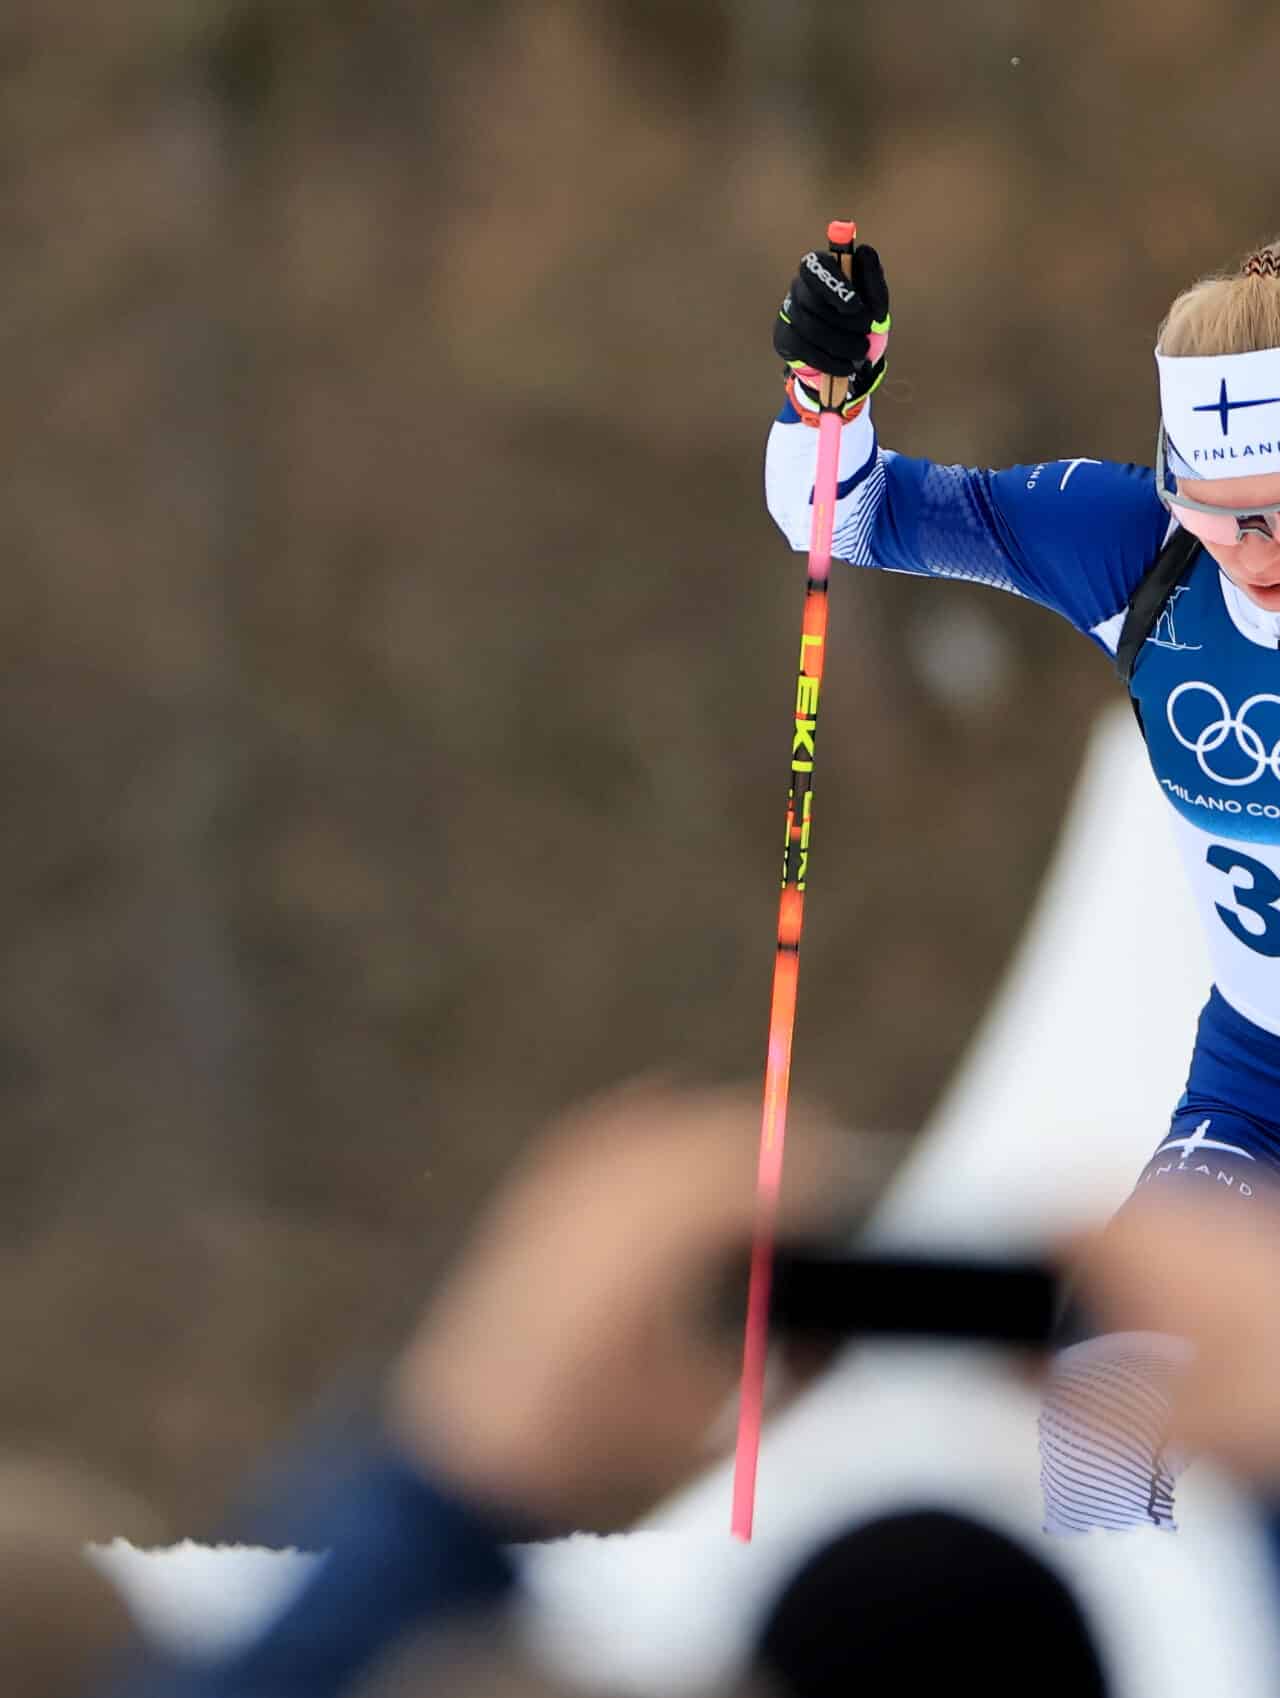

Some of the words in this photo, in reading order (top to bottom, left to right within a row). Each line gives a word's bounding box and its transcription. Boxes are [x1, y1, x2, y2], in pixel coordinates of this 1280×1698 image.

[791, 634, 822, 772] LEKI
[1161, 779, 1242, 813] MILANO
[1138, 1162, 1252, 1196] INLAND
